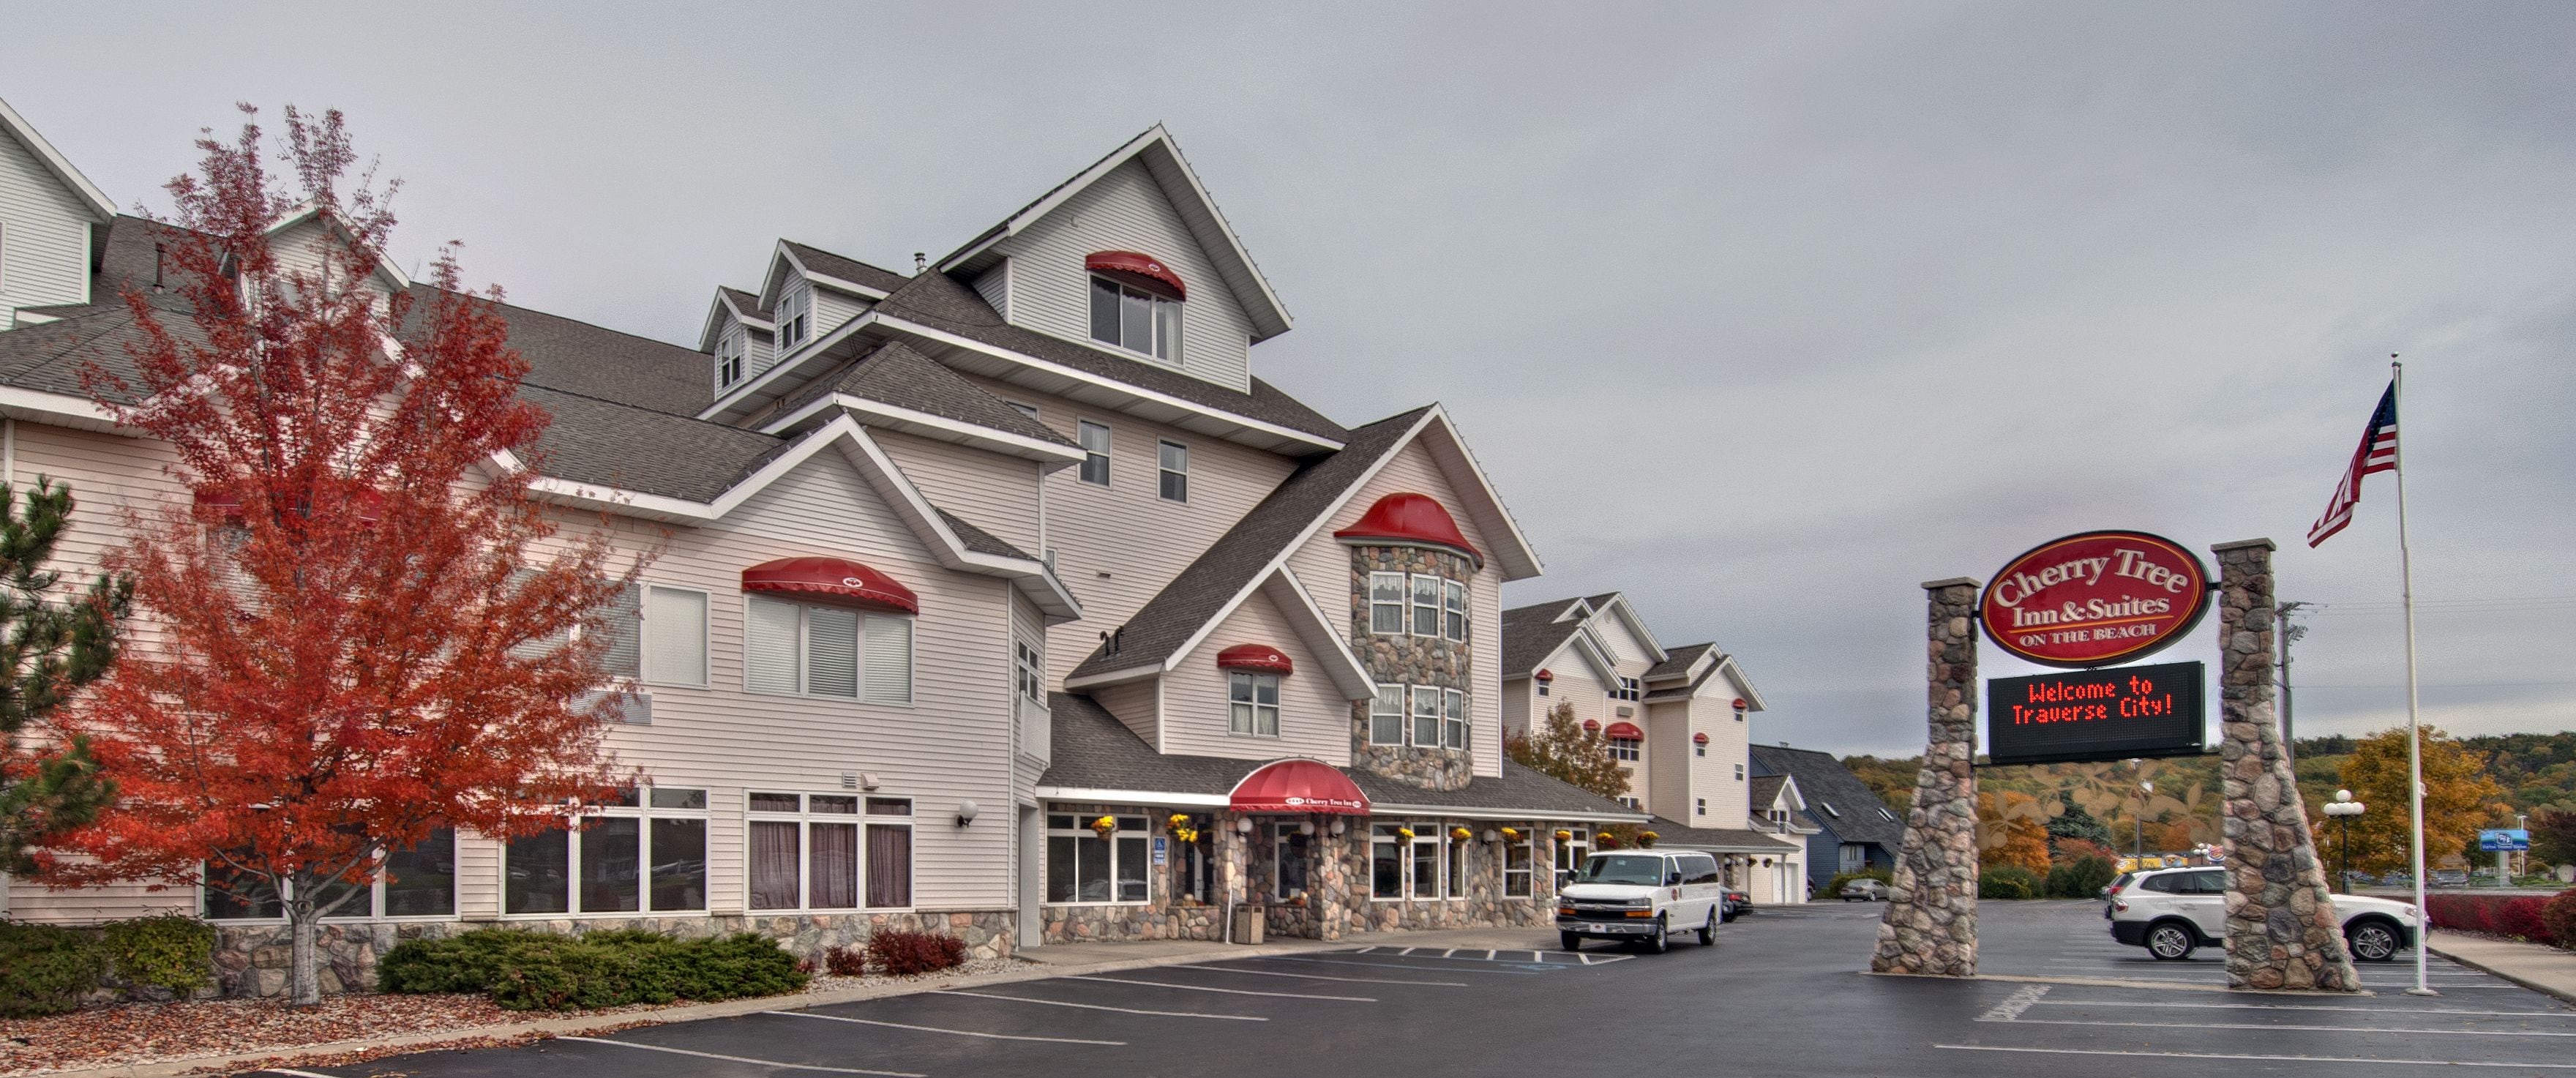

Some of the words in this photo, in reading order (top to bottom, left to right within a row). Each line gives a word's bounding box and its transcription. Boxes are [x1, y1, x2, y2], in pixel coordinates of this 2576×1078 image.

[1993, 556, 2110, 607] Cherry
[2113, 548, 2189, 594] Tree
[2019, 634, 2047, 647] ON
[2050, 630, 2089, 644] THE
[2093, 624, 2157, 643] BEACH
[2028, 681, 2116, 703] Welcome
[2129, 675, 2153, 695] to
[2012, 703, 2108, 725] Traverse
[2120, 693, 2172, 717] City!
[1305, 797, 1328, 806] Cherry
